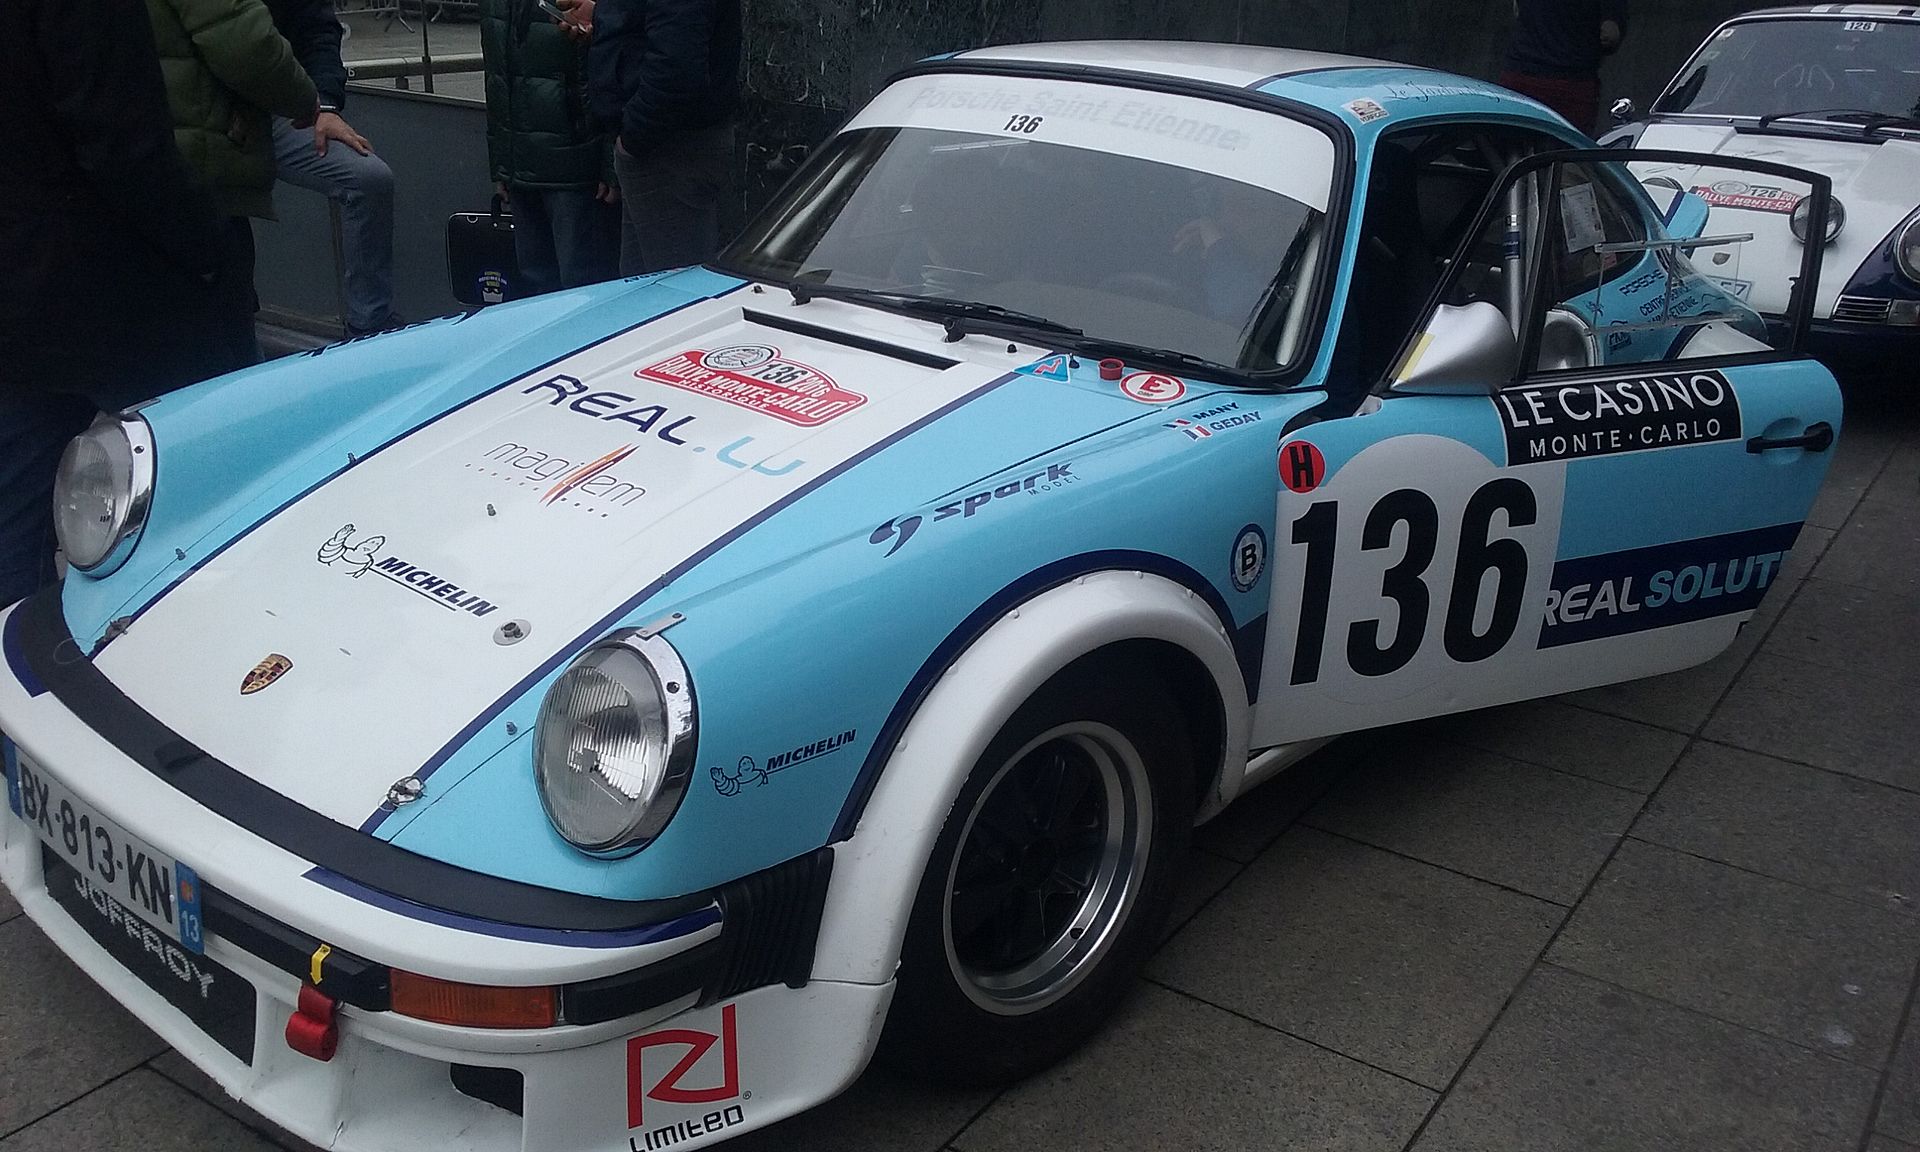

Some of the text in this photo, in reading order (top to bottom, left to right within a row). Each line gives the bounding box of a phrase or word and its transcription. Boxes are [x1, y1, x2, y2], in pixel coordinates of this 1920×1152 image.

[907, 85, 1247, 152] Porsche Saint Etienne
[1002, 113, 1045, 135] 136
[649, 354, 717, 382] RALLYE
[704, 370, 851, 420] MONTE-CARLO
[677, 379, 772, 409] HISTORIQUE
[756, 362, 832, 398] 136 2016
[1500, 374, 1724, 428] LE CASINO
[1210, 411, 1262, 431] GEDAY
[1530, 417, 1721, 458] MONTE CARLO
[1028, 475, 1082, 497] MODEL
[1288, 445, 1315, 489] H
[933, 462, 1073, 519] spark
[1241, 543, 1257, 574] B
[375, 556, 499, 618] MICHELIN
[1289, 477, 1538, 687] 136
[1542, 576, 1641, 627] REAL
[766, 729, 857, 771] MICHELIN
[19, 761, 173, 926] BX-813-KN
[179, 910, 201, 943] 13
